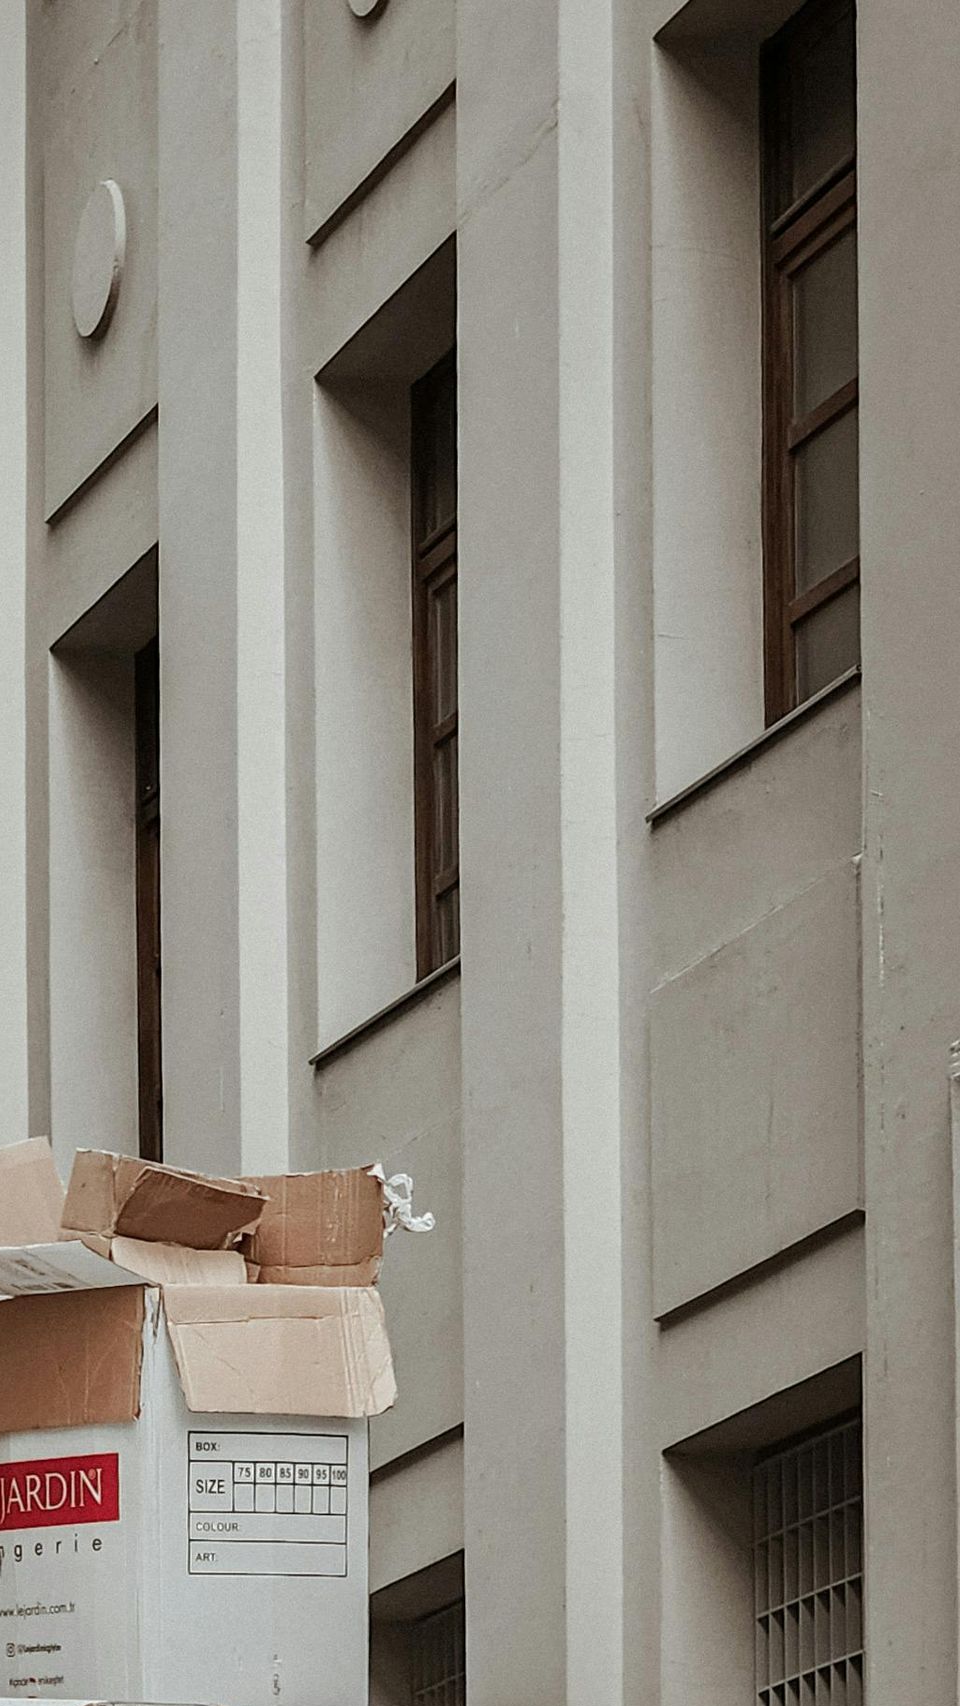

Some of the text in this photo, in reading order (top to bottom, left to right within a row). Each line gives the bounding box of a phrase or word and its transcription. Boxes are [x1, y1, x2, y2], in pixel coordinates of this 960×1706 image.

[195, 1466, 347, 1495] SIZE 75 80 85 90 95 100
